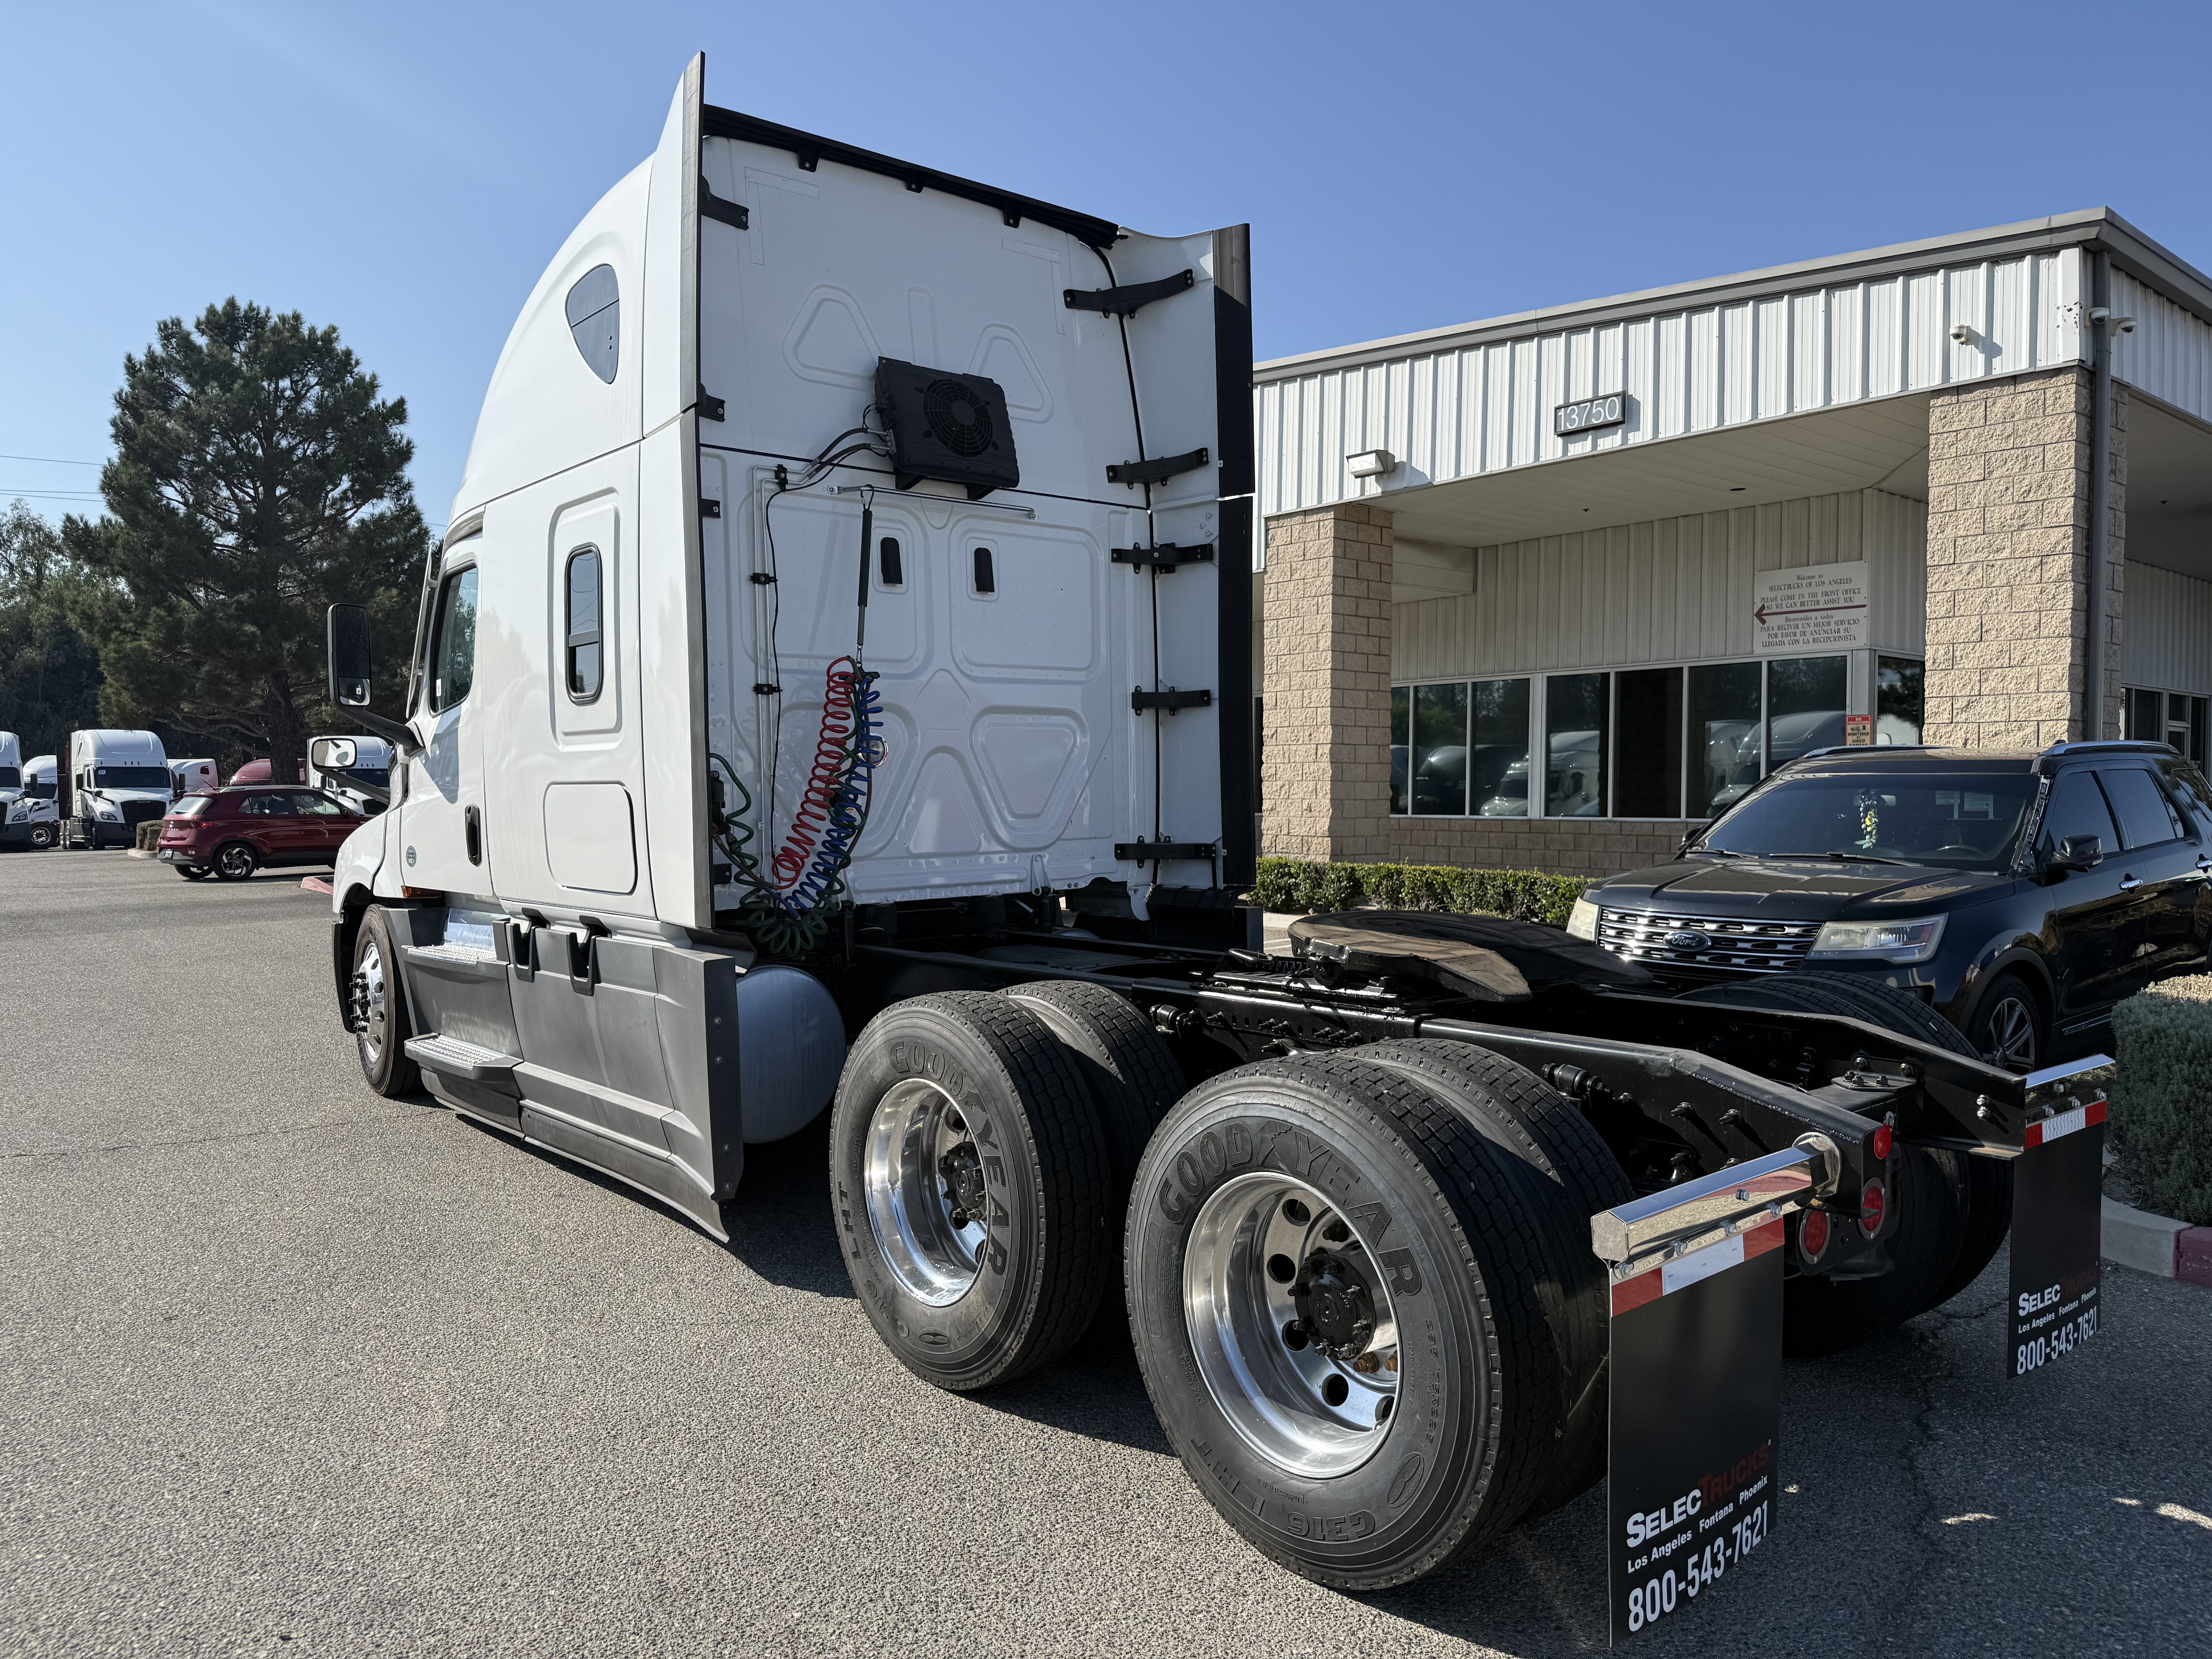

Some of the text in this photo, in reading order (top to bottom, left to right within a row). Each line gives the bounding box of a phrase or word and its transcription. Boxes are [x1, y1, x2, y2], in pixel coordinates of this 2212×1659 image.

[1558, 397, 1619, 431] 13750
[1769, 582, 1803, 592] SELECTRUCKS
[1828, 577, 1852, 586] ANGELES
[1785, 615, 1812, 623] Bienvenidos
[1809, 628, 1840, 636] ANUNCIAR
[1812, 635, 1856, 643] RECEPCIONISTA
[1672, 933, 1698, 946] Ford
[2018, 1286, 2097, 1334] Los Angeles Fontana Phoenix
[2017, 1305, 2097, 1374] 800-543-7621
[1287, 1510, 1376, 1541] G316
[1628, 1475, 1768, 1573] Los Angeles Fontana Phoenix
[1628, 1499, 1768, 1632] 800-543-7621
